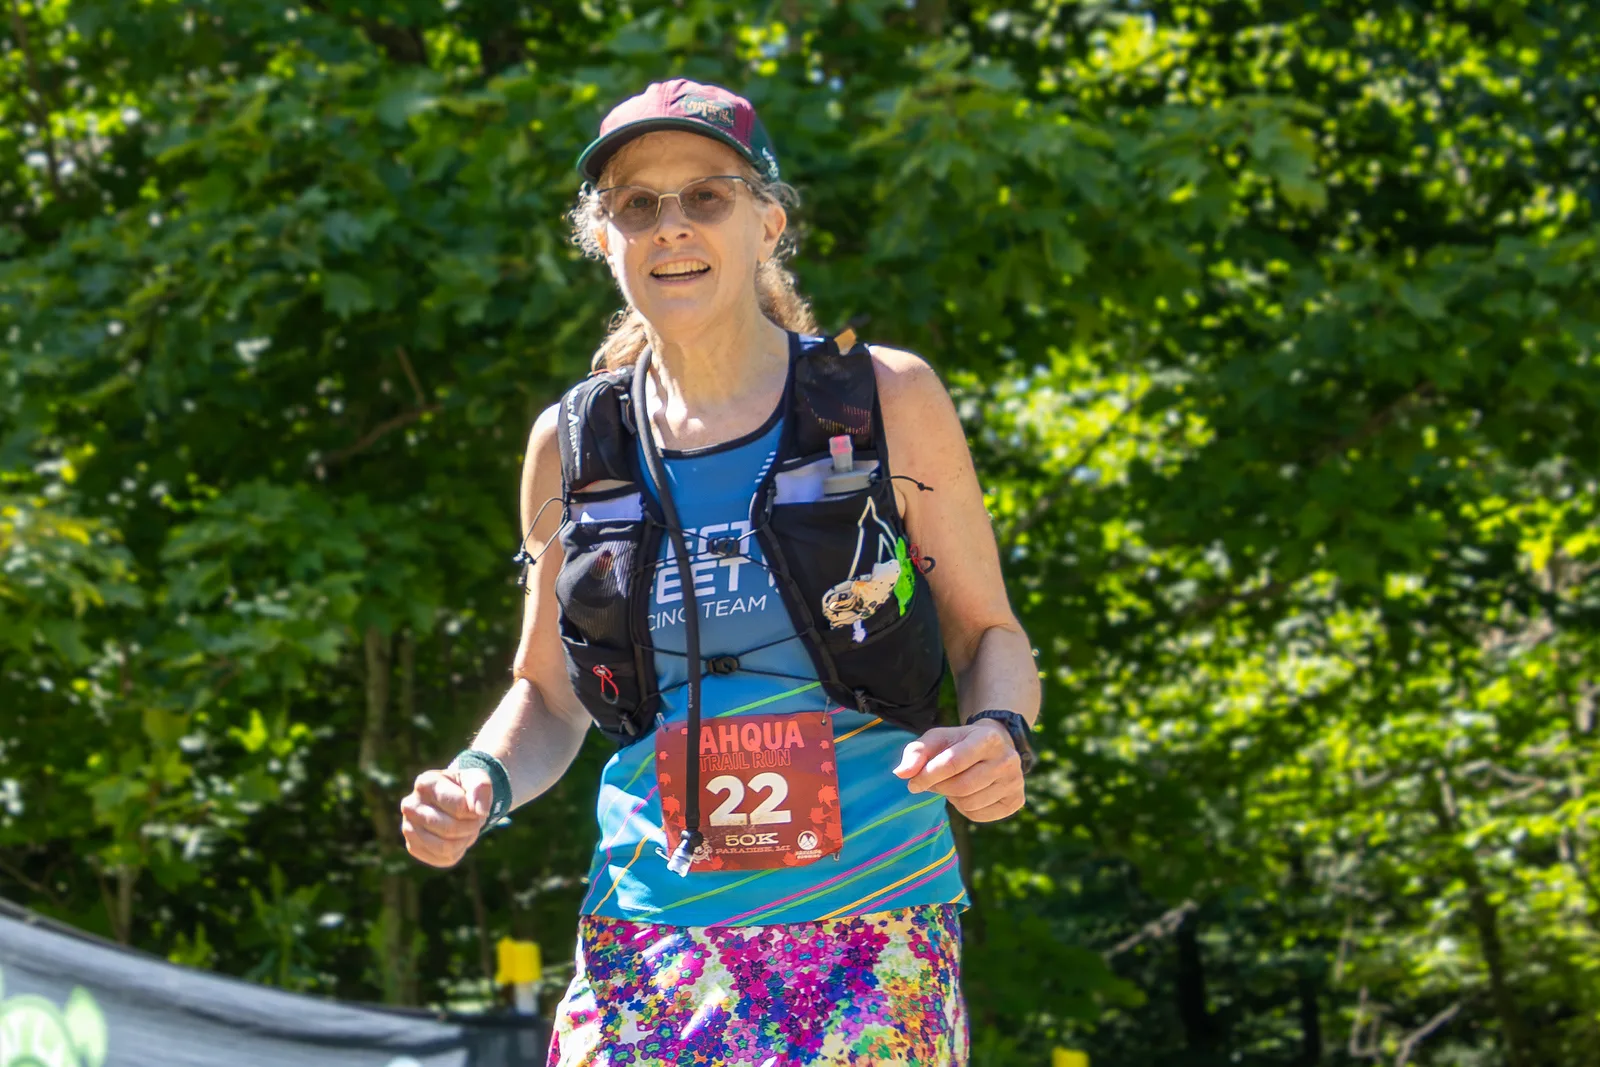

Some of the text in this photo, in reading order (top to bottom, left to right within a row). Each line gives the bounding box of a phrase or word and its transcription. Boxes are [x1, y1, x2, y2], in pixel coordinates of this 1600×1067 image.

[650, 556, 751, 604] EET
[702, 595, 767, 618] TEAM
[681, 720, 805, 754] AHQUA
[699, 749, 791, 772] TRAIL RUN
[705, 772, 792, 826] 22
[725, 832, 779, 847] 50K
